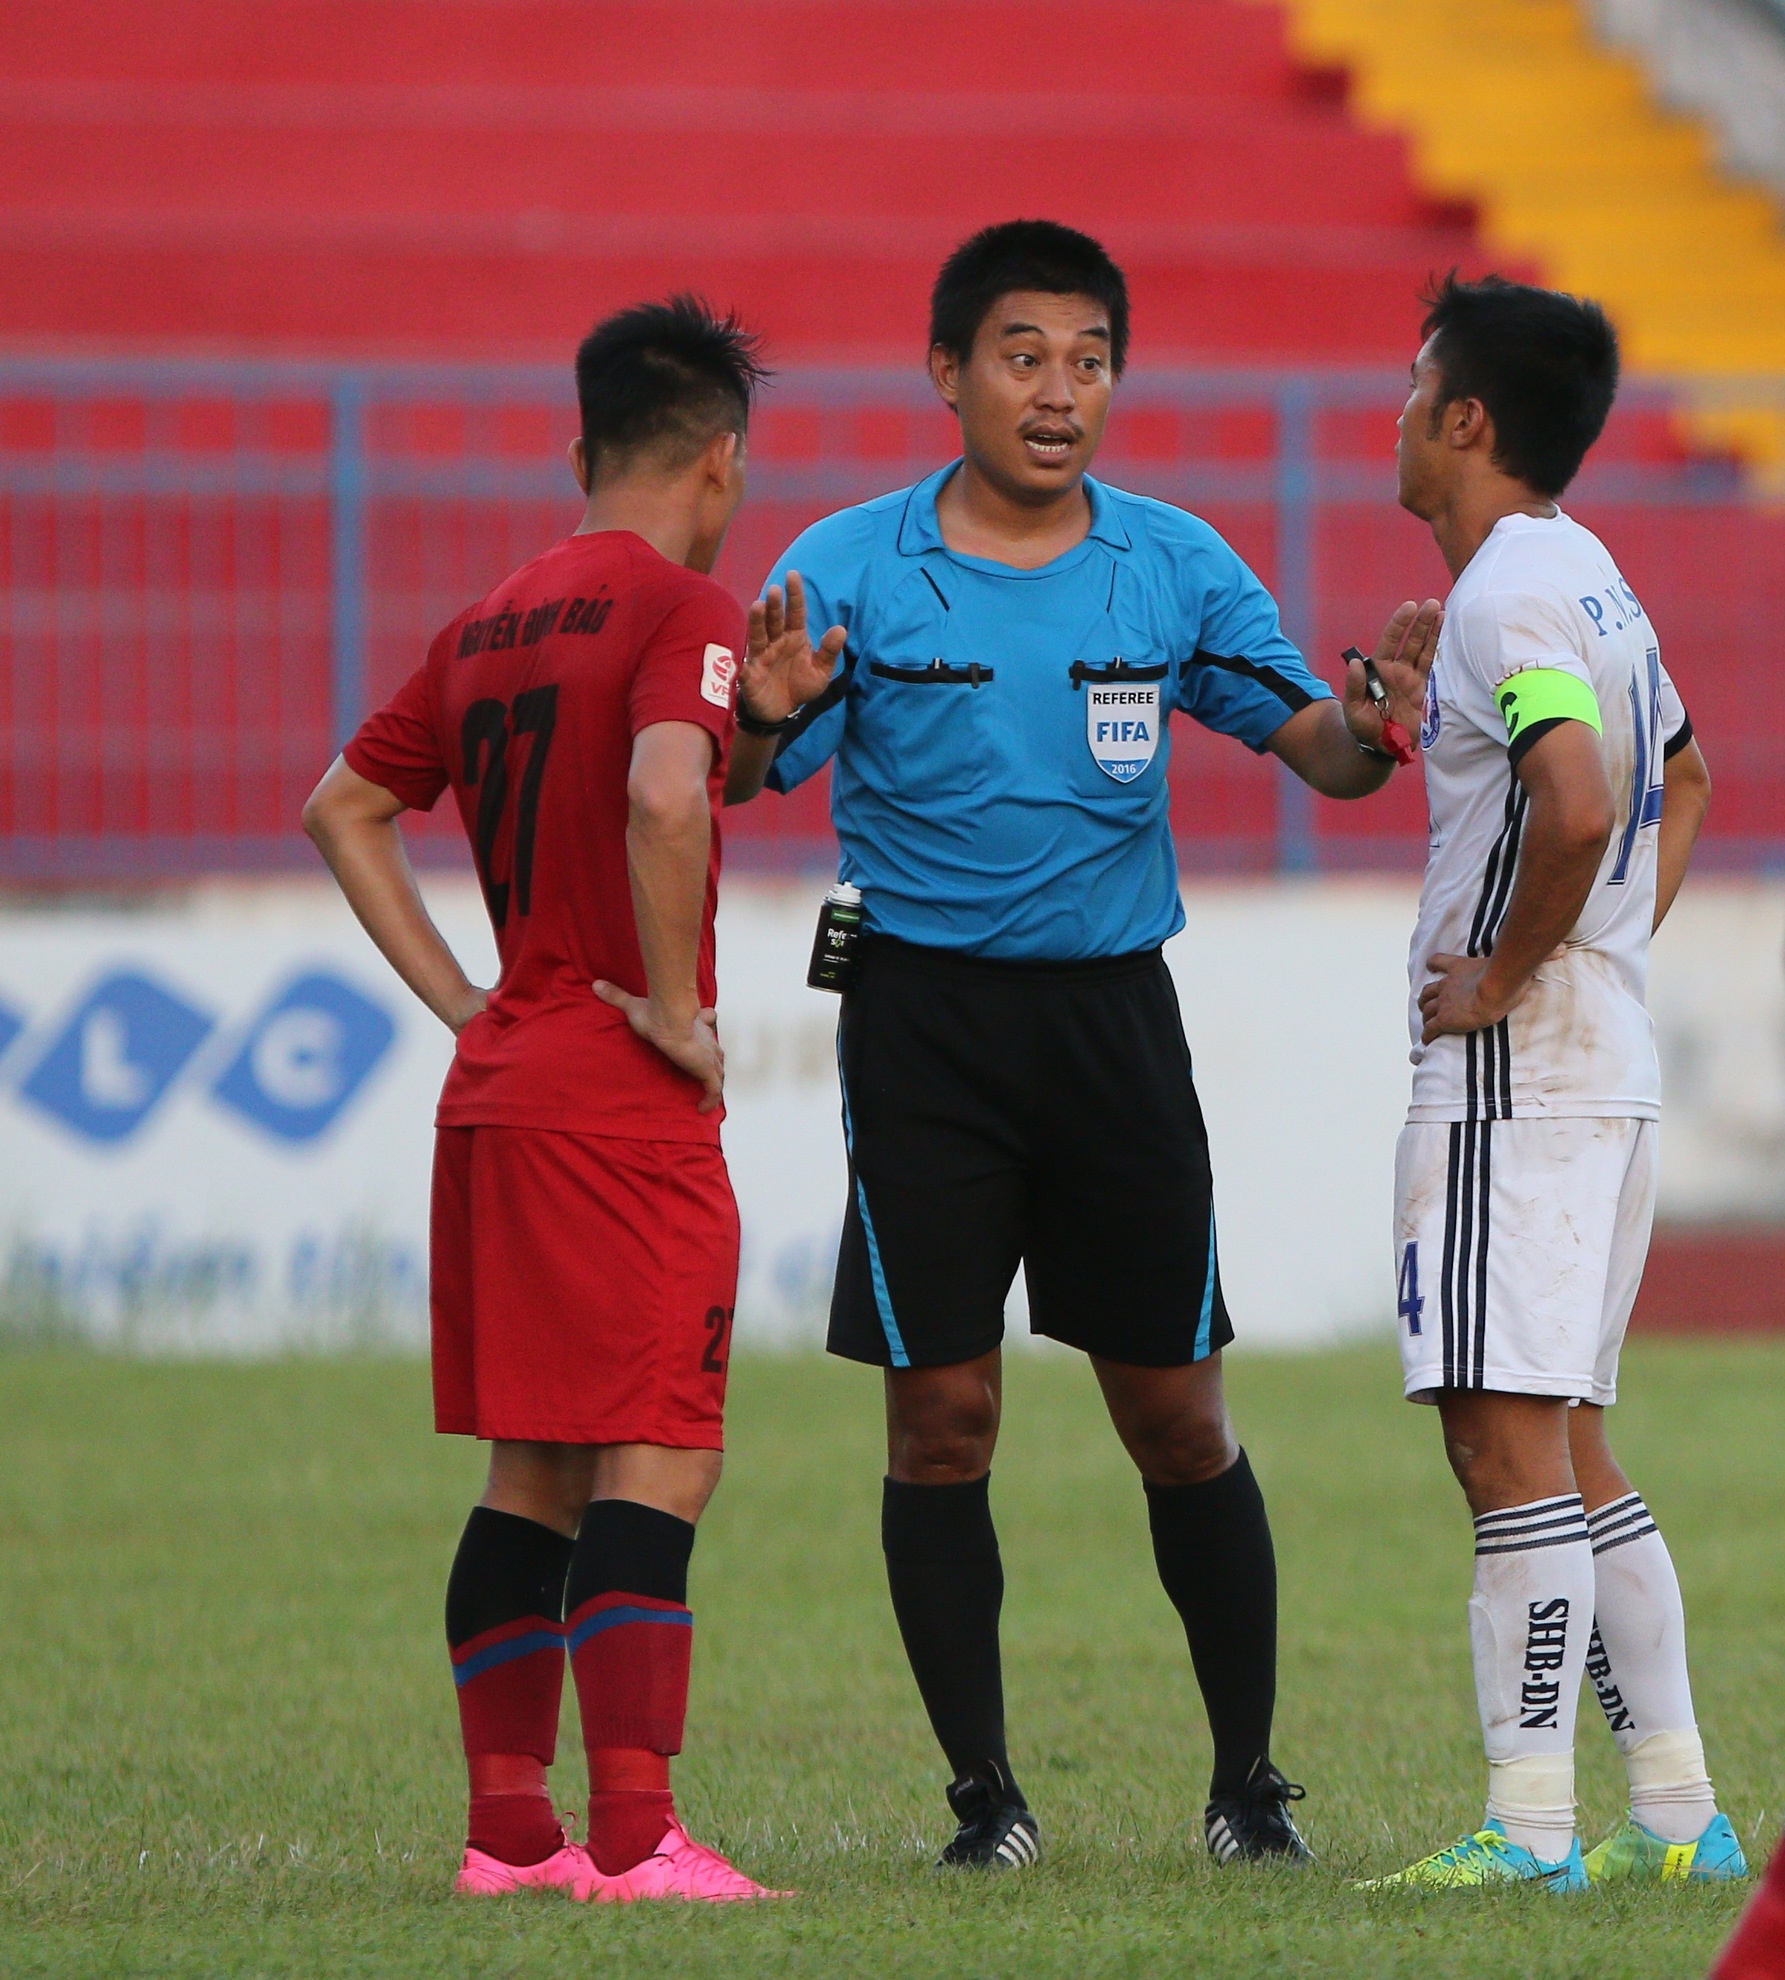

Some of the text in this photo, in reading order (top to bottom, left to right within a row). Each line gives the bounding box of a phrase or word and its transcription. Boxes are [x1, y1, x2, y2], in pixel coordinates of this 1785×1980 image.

[1093, 692, 1154, 705] REFEREE
[1096, 721, 1150, 743] FIFA
[1111, 763, 1137, 774] 2016
[460, 683, 560, 928] 27
[701, 1306, 735, 1374] 2
